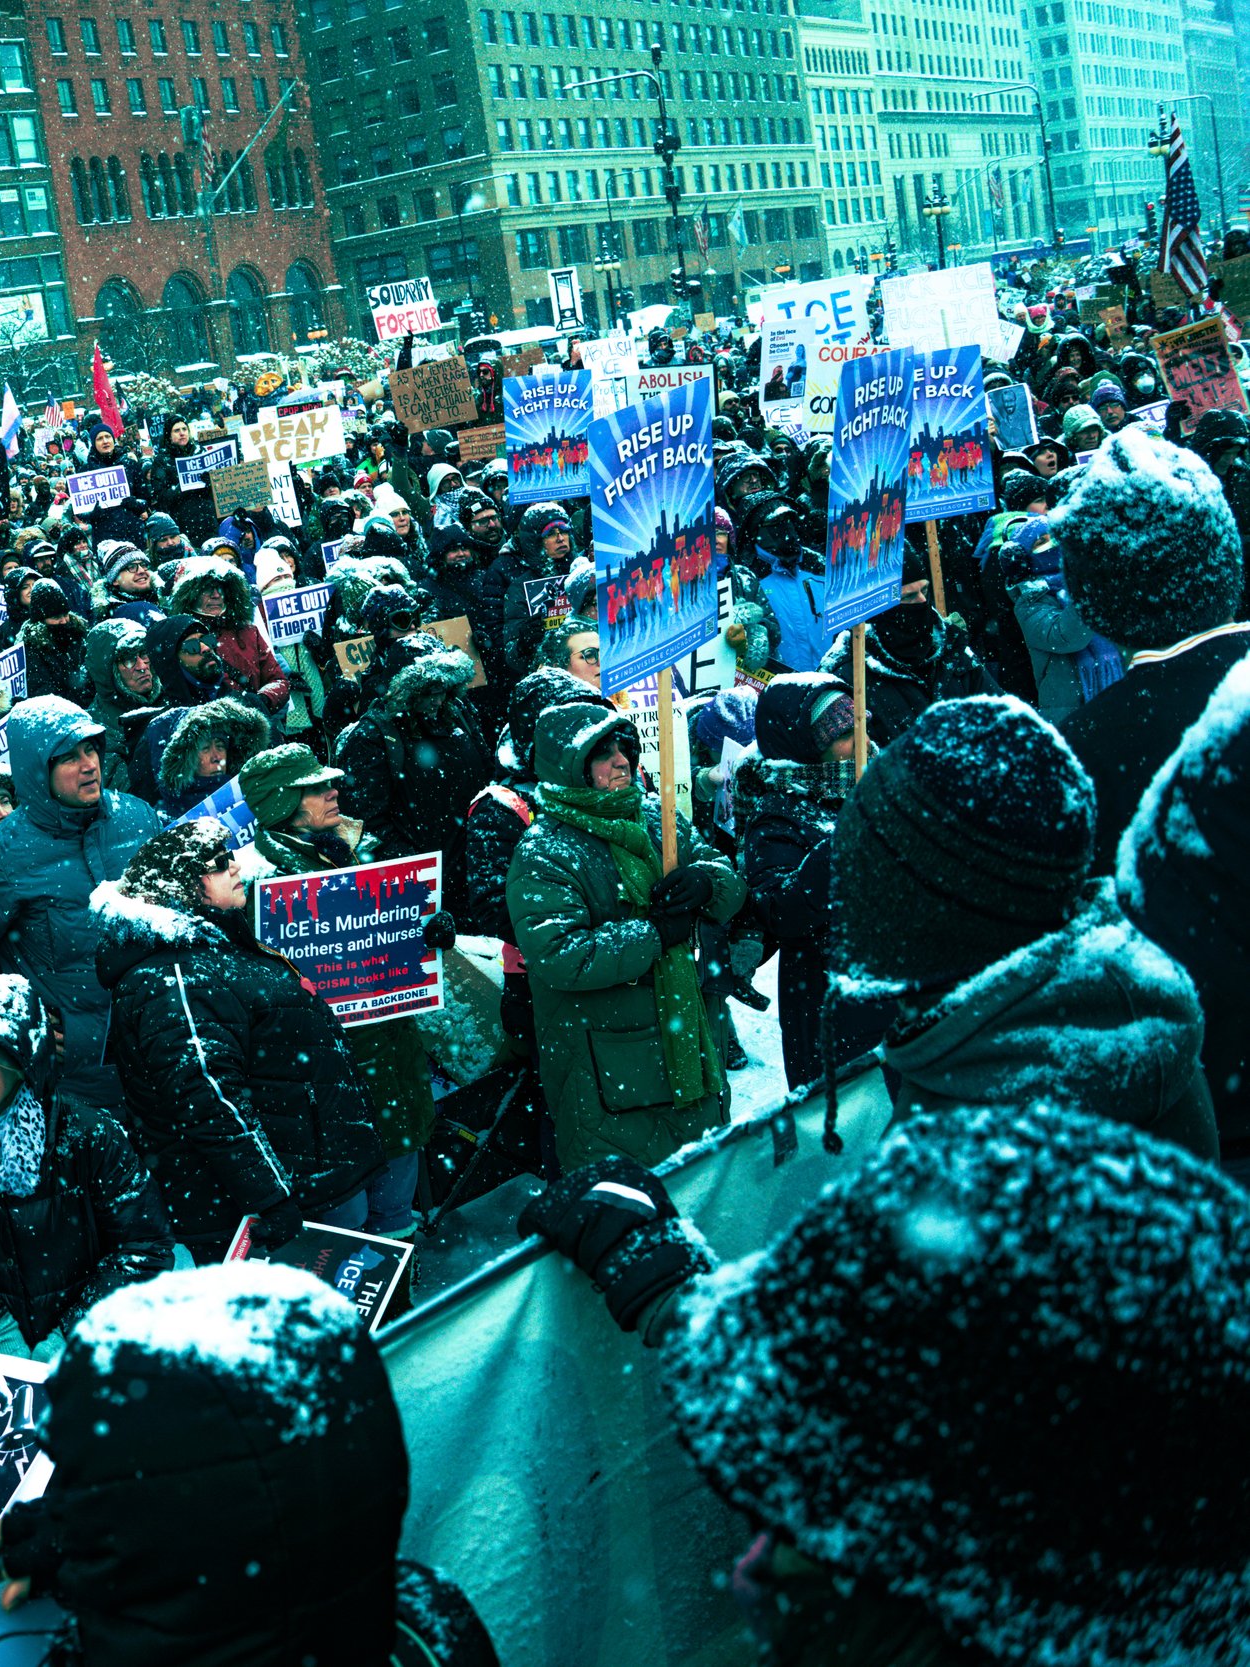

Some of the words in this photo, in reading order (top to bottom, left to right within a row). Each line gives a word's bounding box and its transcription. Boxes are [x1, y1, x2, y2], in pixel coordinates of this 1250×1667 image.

[368, 279, 430, 310] SOLIDARITY
[376, 307, 440, 339] FOREVER
[397, 371, 410, 386] AS
[428, 358, 462, 376] TEMPER
[414, 376, 441, 390] WHEN
[442, 368, 468, 384] RAGE
[931, 366, 958, 379] UP
[398, 393, 410, 407] IS
[413, 391, 422, 404] A
[424, 381, 460, 401] DECIBEL
[410, 400, 431, 416] CAN
[434, 389, 473, 410] ACTUALLY
[522, 385, 554, 401] RISE
[557, 384, 577, 395] UP
[854, 377, 885, 408] RISE
[888, 376, 904, 397] UP
[926, 384, 976, 400] BACK
[421, 409, 441, 425] GET
[513, 399, 551, 419] FIGHT
[554, 397, 588, 411] BACK
[249, 411, 329, 447] BREAK
[617, 421, 664, 464] RISE
[669, 414, 694, 437] UP
[841, 407, 881, 447] FIGHT
[881, 405, 908, 431] BACK
[185, 458, 202, 472] ICE
[203, 449, 226, 468] OUT!
[258, 438, 320, 464] ICE!
[77, 476, 95, 491] ICE
[95, 470, 119, 488] OUT!
[604, 453, 659, 507] FIGHT
[663, 443, 708, 470] BACK
[109, 485, 128, 501] ICE!
[276, 596, 297, 616] ICE
[301, 588, 330, 612] OUT!
[620, 652, 664, 682] INDIVISIBLE
[664, 636, 694, 658] CHICAGO
[280, 920, 310, 940] ICE
[315, 918, 330, 935] is
[336, 904, 420, 933] Murdering
[280, 943, 343, 960] Mothers
[347, 934, 373, 952] and
[377, 926, 423, 946] Nurses
[315, 963, 342, 974] This
[346, 959, 357, 970] is
[361, 953, 389, 968] what
[354, 969, 385, 985] looks
[388, 966, 409, 978] like
[337, 1001, 358, 1013] GET
[361, 1000, 369, 1009] A
[371, 987, 428, 1007] BACKBONE!
[364, 1005, 395, 1019] YOUR
[398, 997, 433, 1012] HANDS
[338, 1257, 366, 1292] ICE
[356, 1278, 383, 1318] THE
